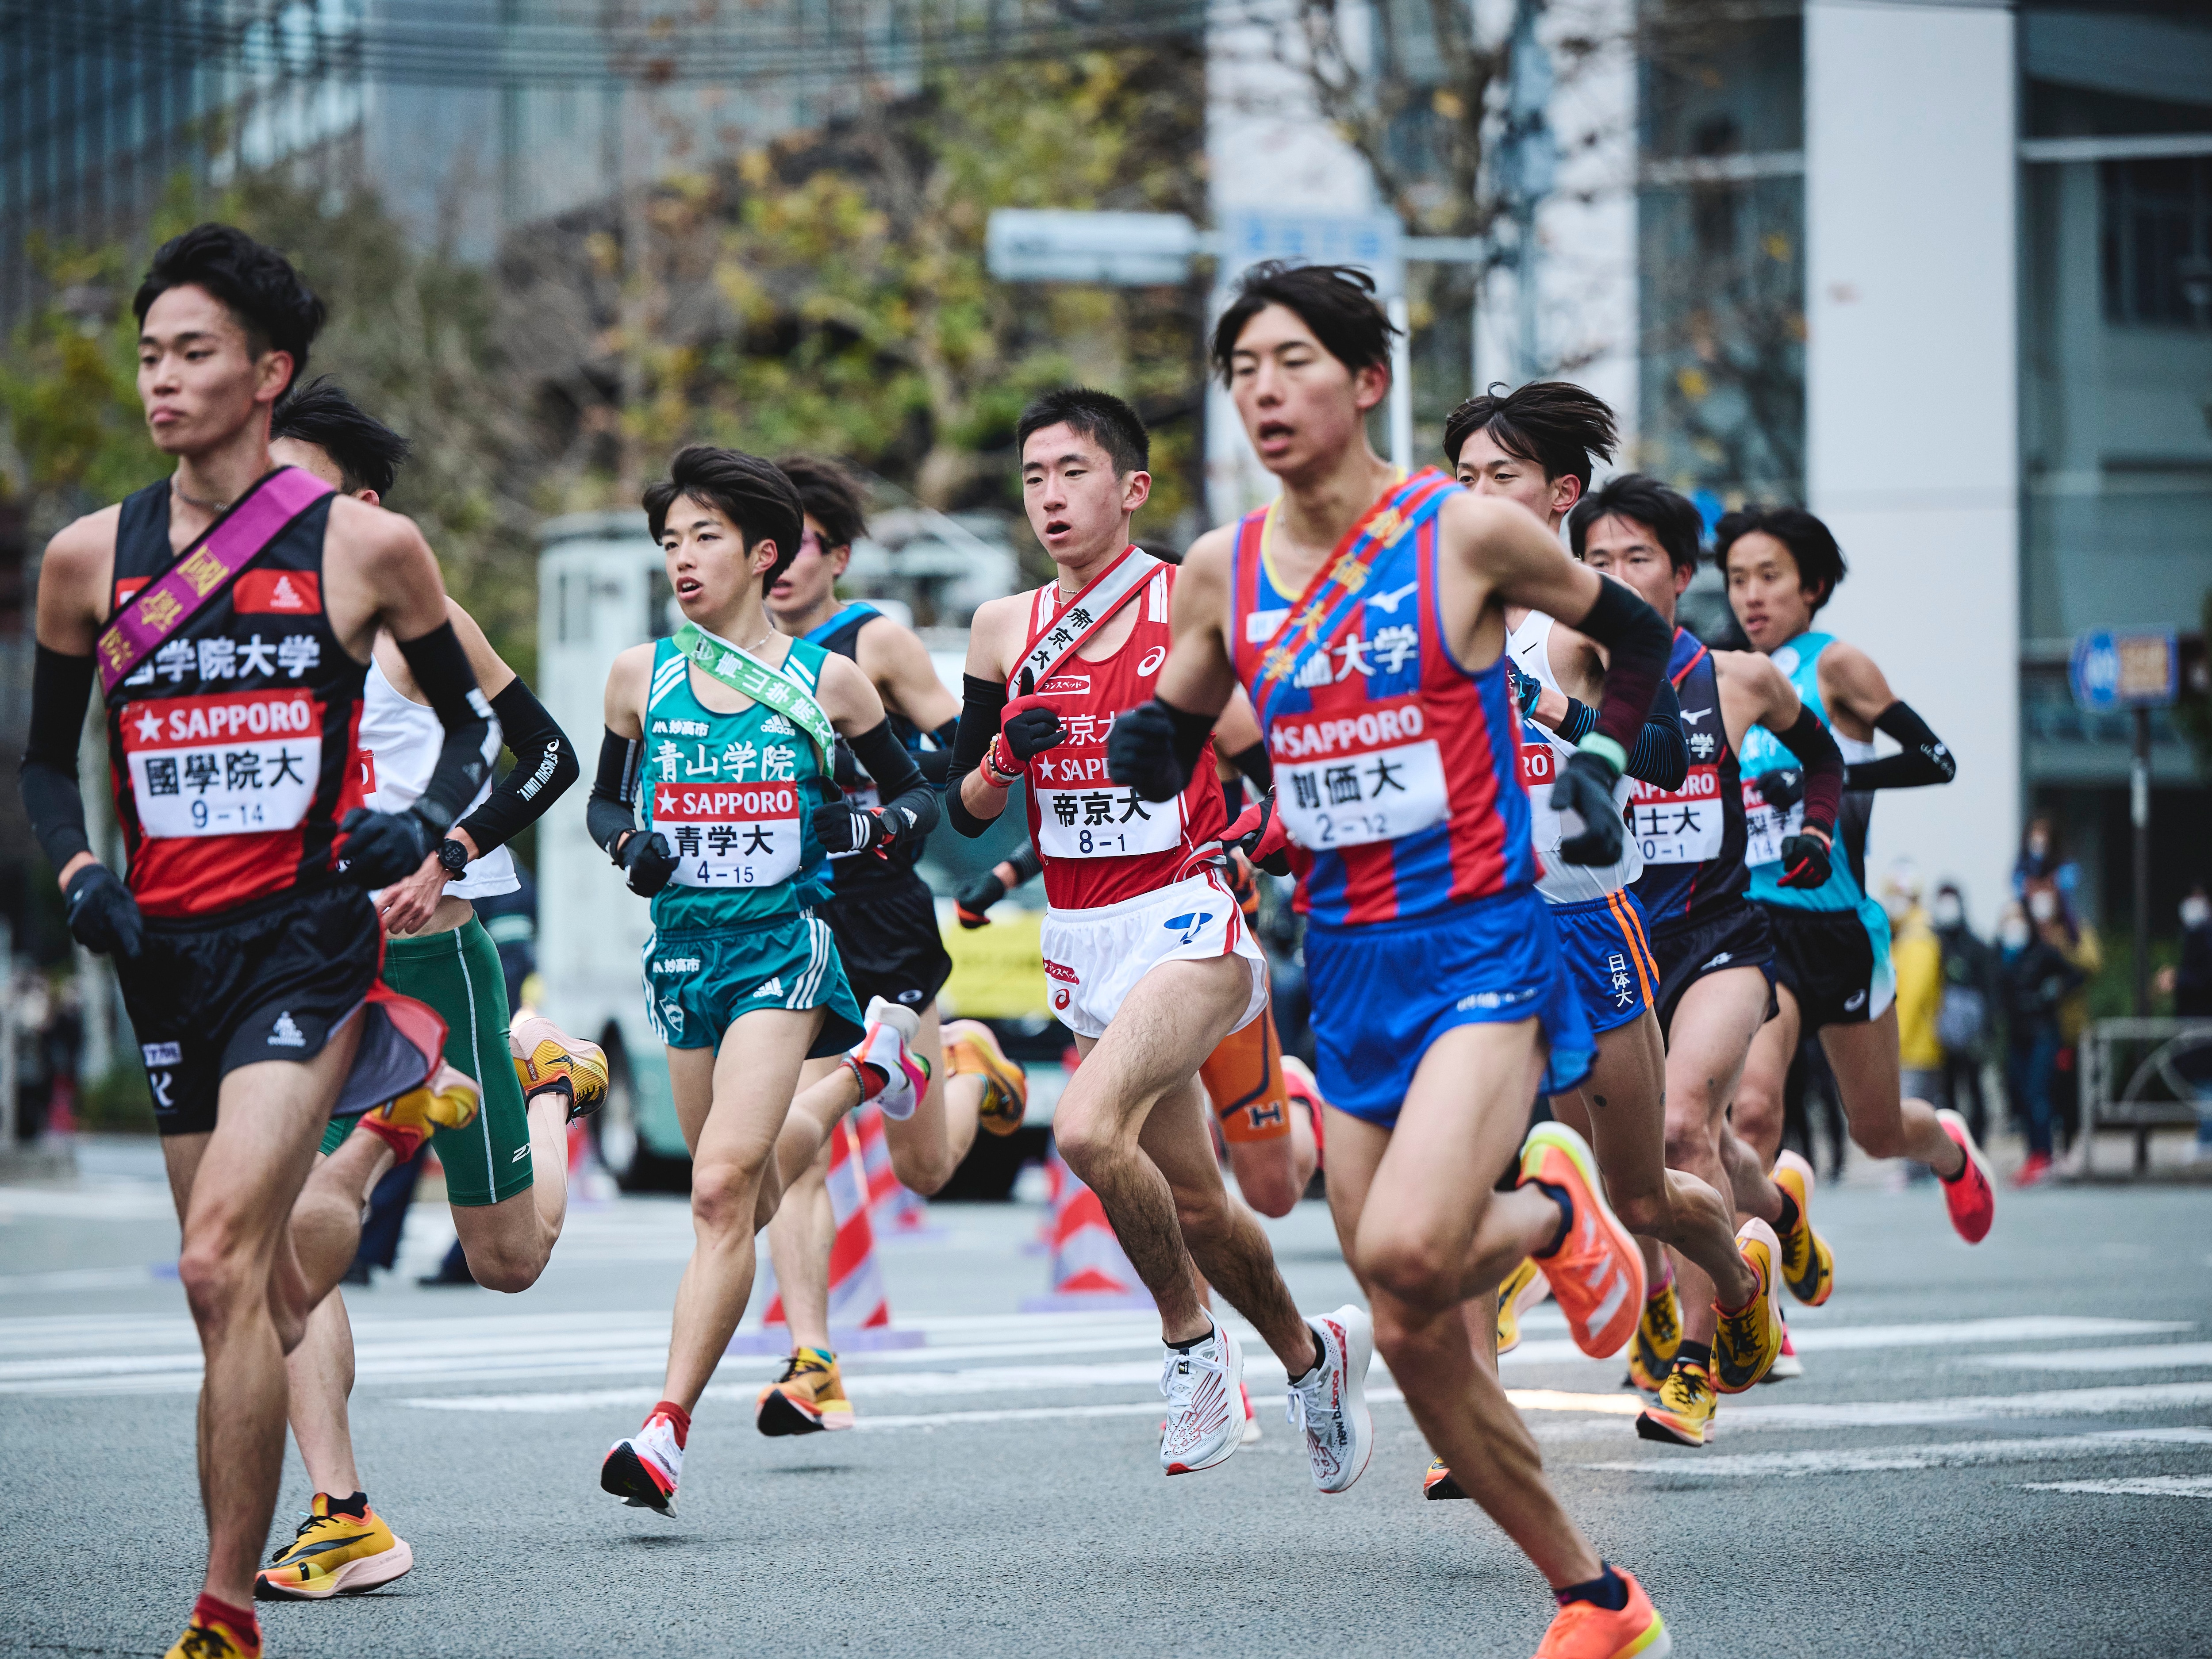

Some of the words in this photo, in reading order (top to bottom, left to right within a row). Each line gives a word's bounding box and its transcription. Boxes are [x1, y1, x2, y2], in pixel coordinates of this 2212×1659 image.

[1013, 607, 1094, 687] 帝京大
[1045, 681, 1082, 690] ランスベッド
[169, 700, 310, 741] SAPPORO
[669, 719, 709, 737] 妙高市
[760, 723, 795, 736] adidas
[1284, 705, 1424, 757] SAPPORO
[146, 748, 303, 795] 國學院大
[534, 751, 558, 784] SENSHU
[652, 740, 796, 782] 青山学院
[1291, 757, 1405, 808] 創価大
[683, 790, 792, 815] SAPPORO
[1053, 788, 1151, 827] 帝京大
[1630, 806, 1701, 837] 士大
[675, 825, 774, 857] 青学大
[1079, 830, 1125, 854] 8-1
[1637, 839, 1684, 860] 0-1
[697, 861, 753, 883] 4-15
[1609, 954, 1633, 1007] 日体大
[1336, 1421, 1348, 1446] new
